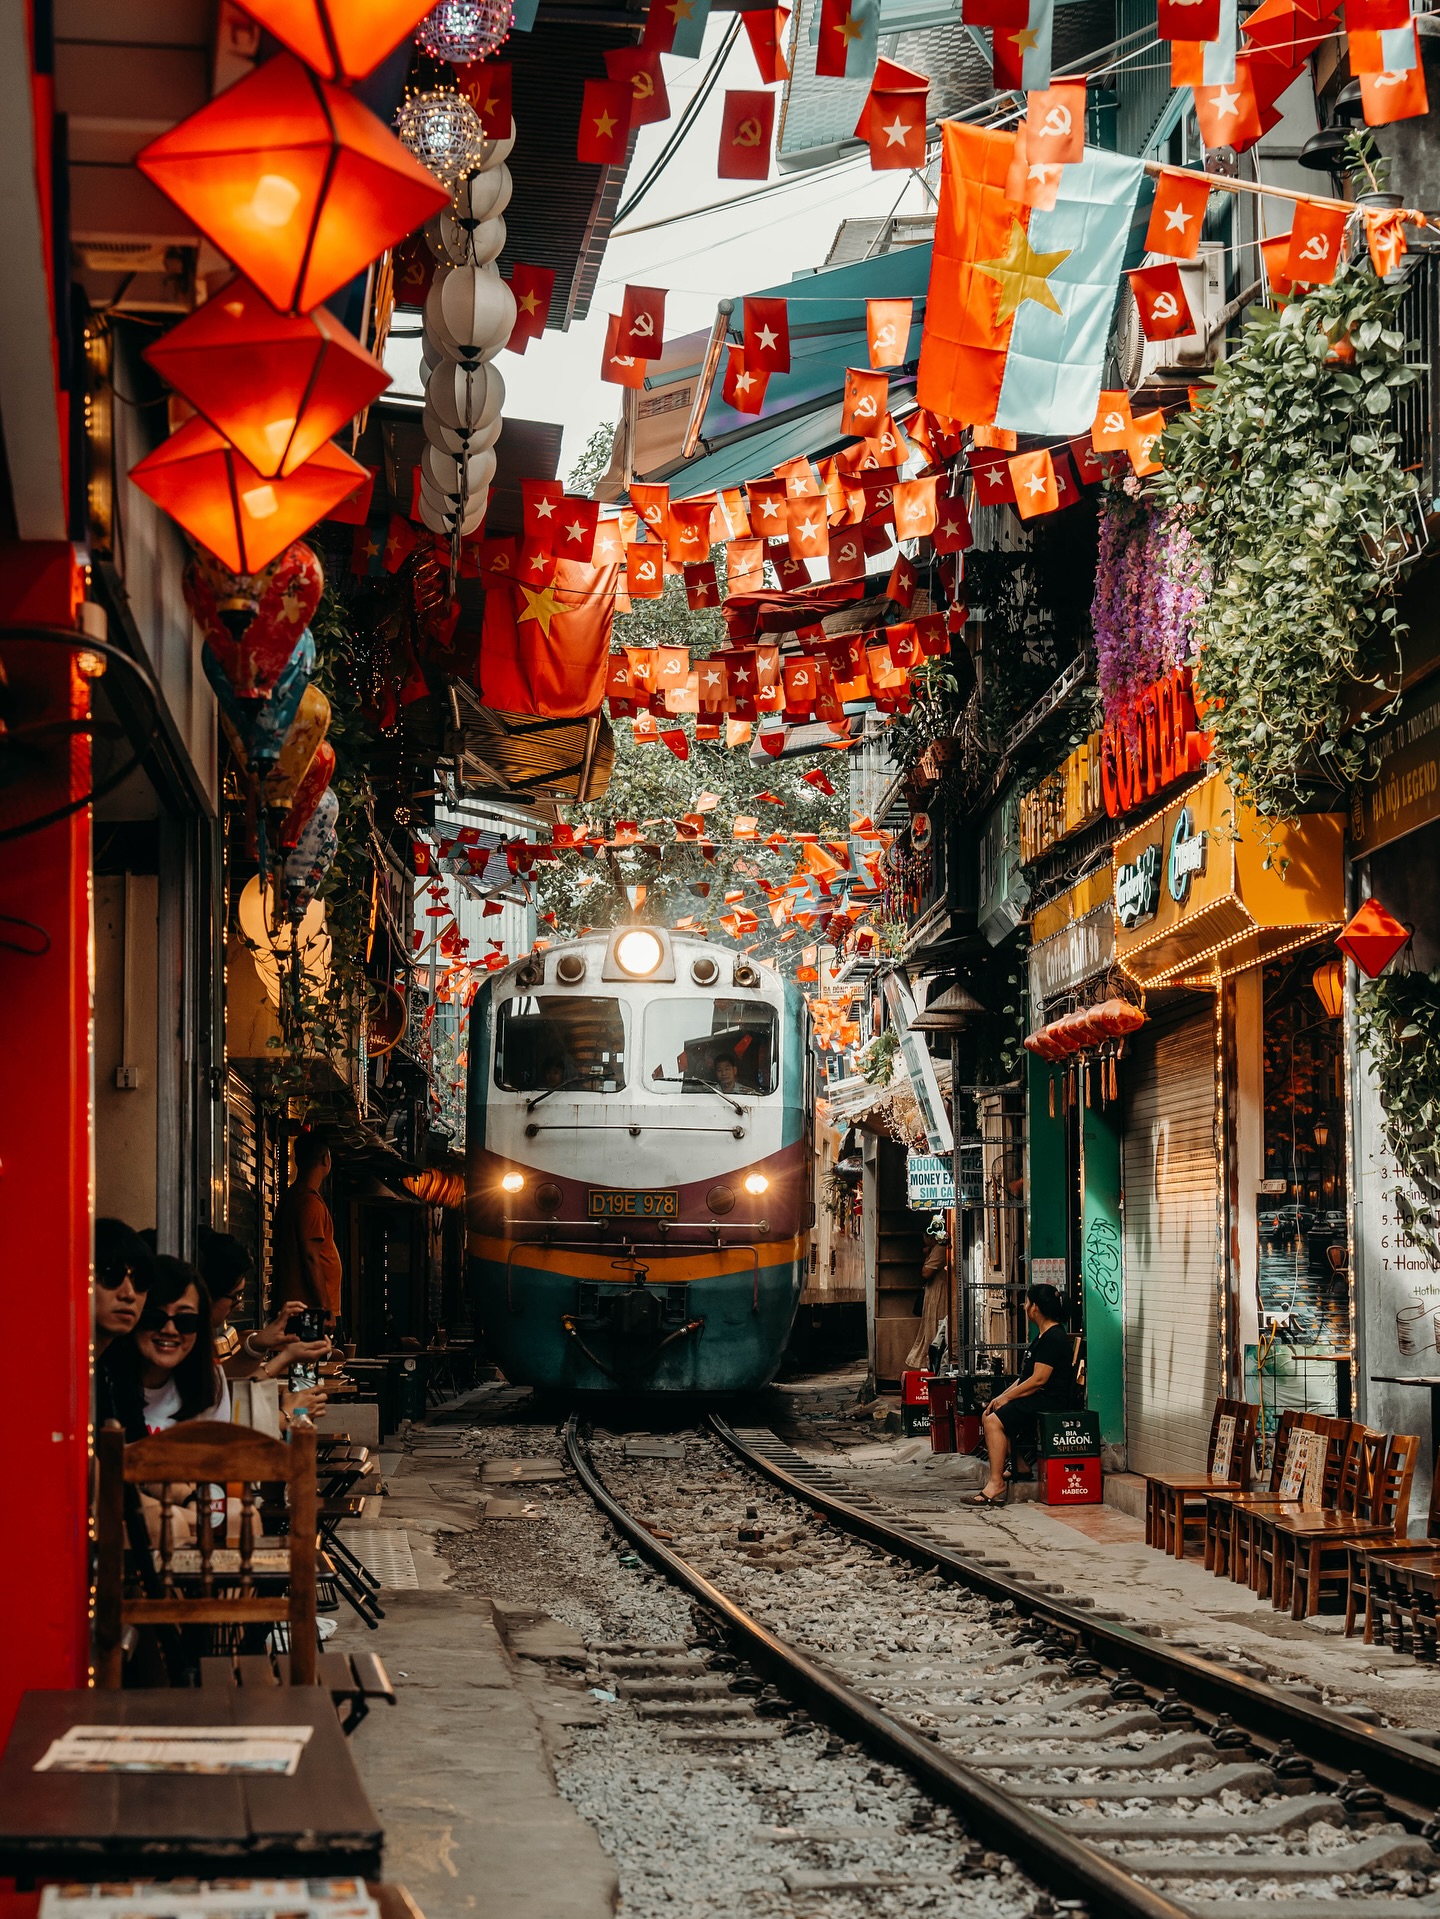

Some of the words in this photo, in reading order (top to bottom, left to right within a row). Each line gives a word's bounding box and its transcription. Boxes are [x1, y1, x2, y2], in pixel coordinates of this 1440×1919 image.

[1401, 760, 1438, 807] LEGEND
[1046, 941, 1070, 987] Coffee
[909, 1157, 953, 1172] BOOKING
[910, 1173, 941, 1186] MONEY
[920, 1187, 938, 1199] SIM
[940, 1186, 965, 1198] CAD
[967, 1185, 980, 1197] 4G
[1381, 1191, 1393, 1202] 4.
[592, 1194, 636, 1213] D19E
[643, 1195, 674, 1214] 978
[1381, 1214, 1393, 1226] 5.
[1381, 1235, 1394, 1249] 6.
[1382, 1258, 1393, 1271] 7.
[1393, 1254, 1429, 1271] Hanoi
